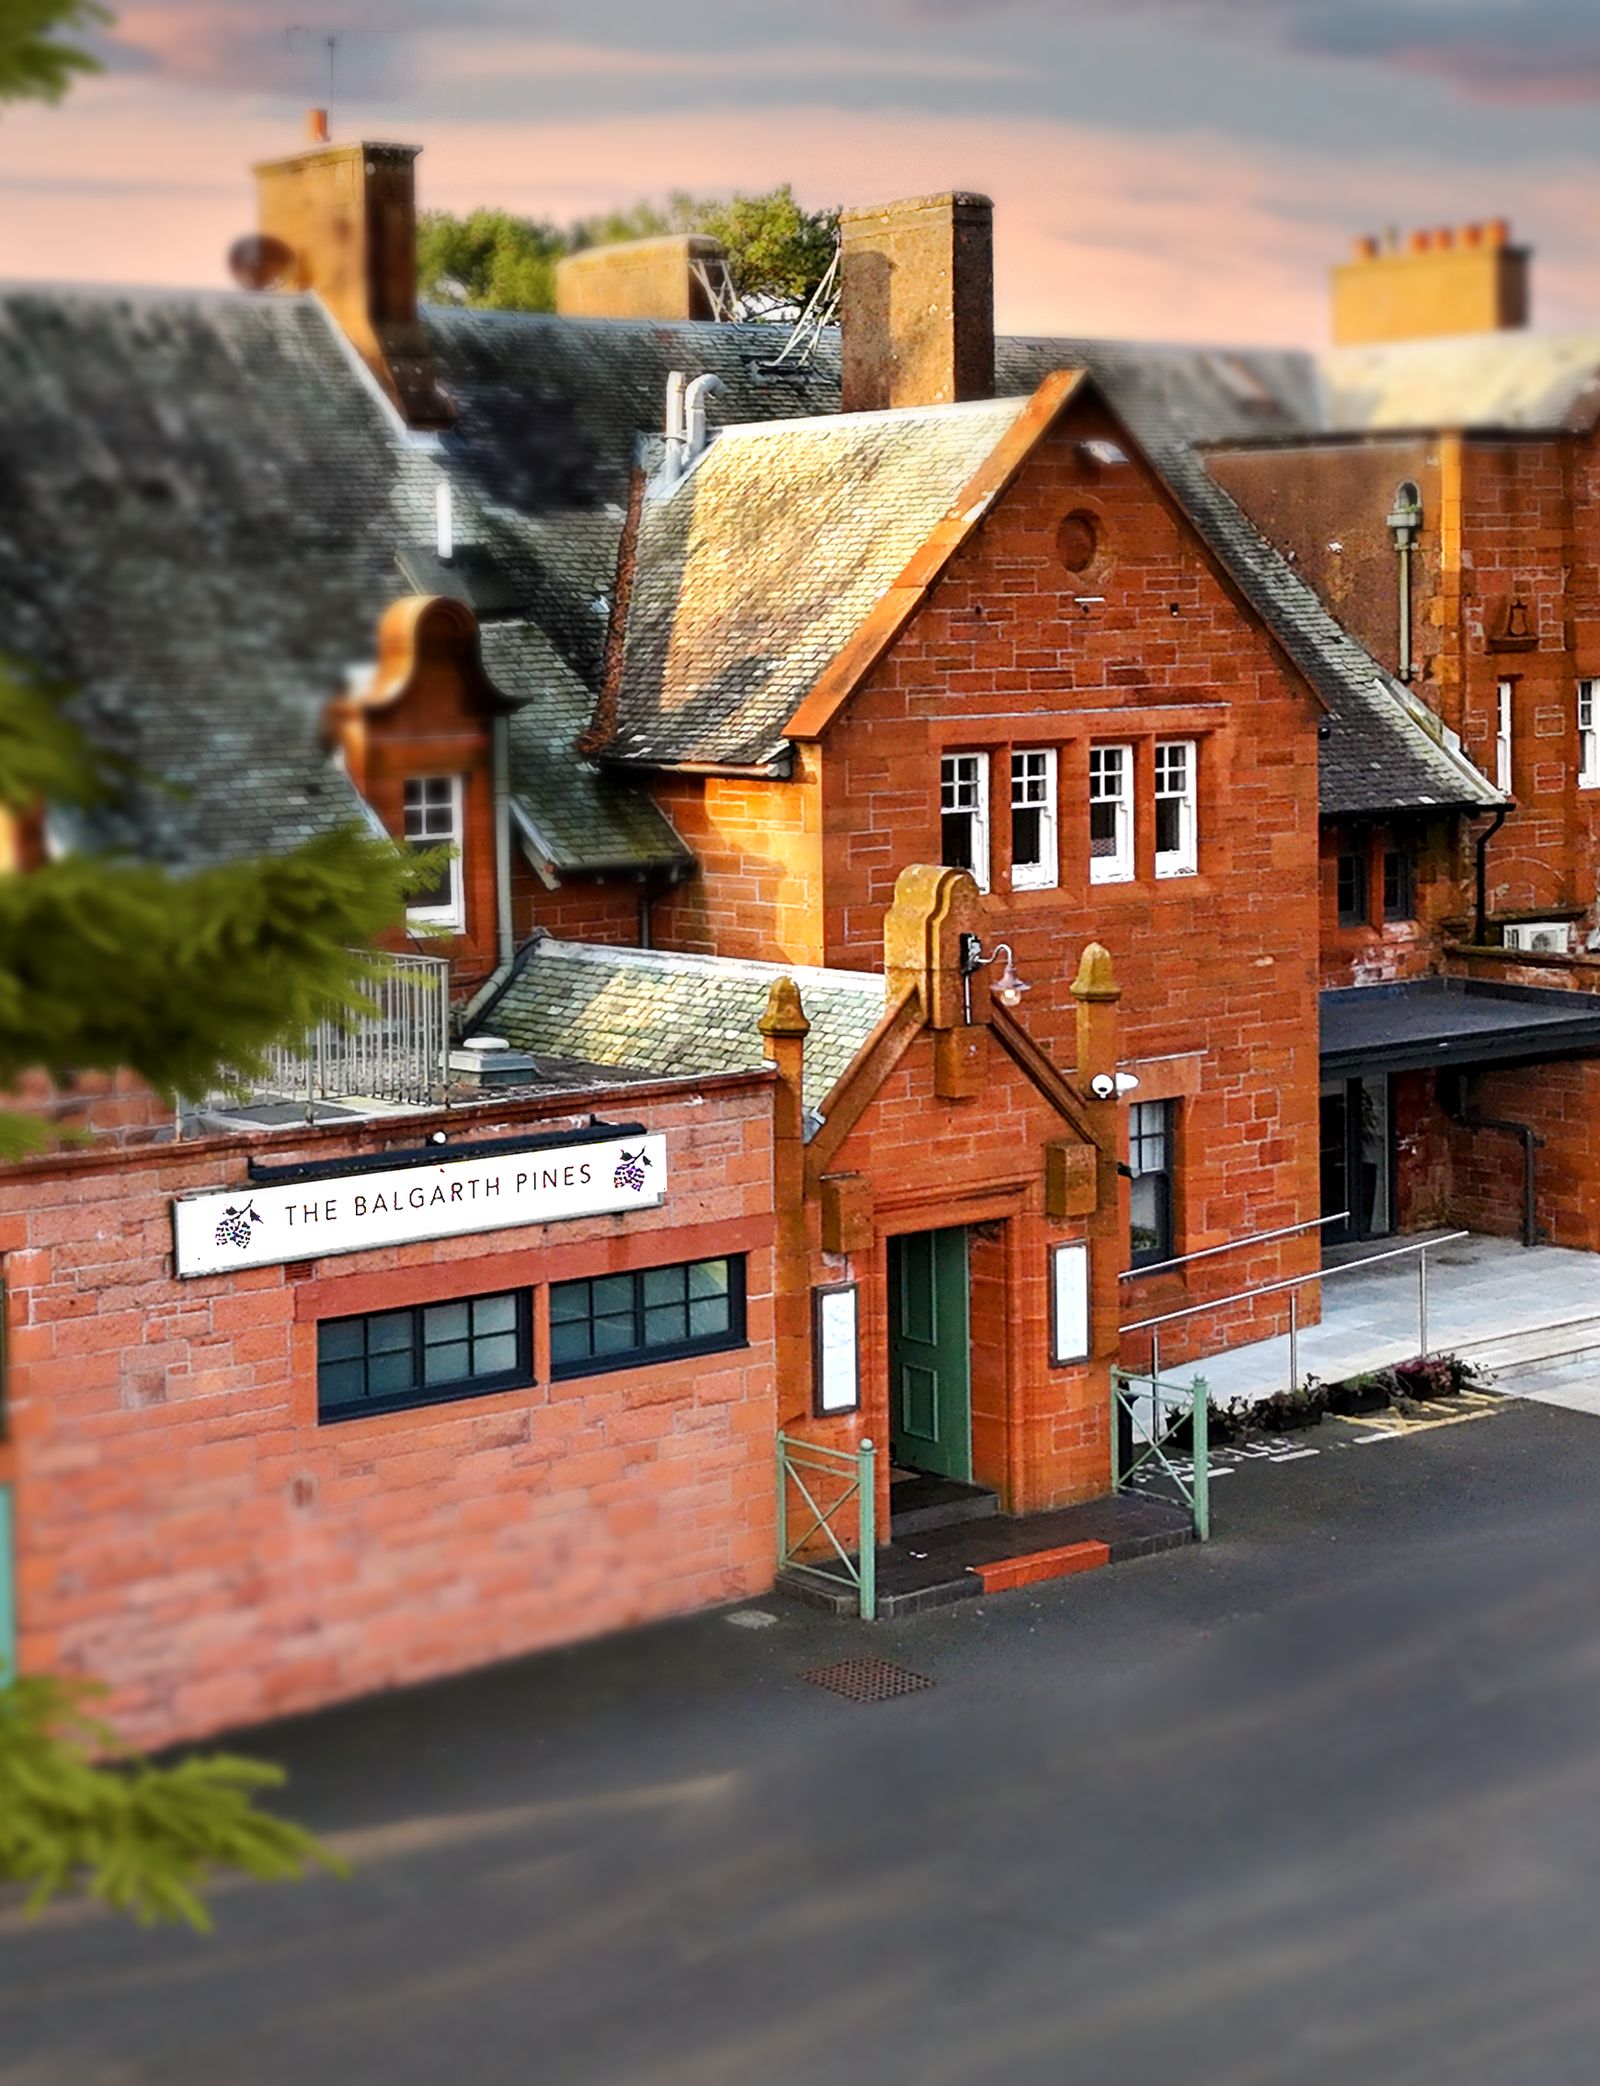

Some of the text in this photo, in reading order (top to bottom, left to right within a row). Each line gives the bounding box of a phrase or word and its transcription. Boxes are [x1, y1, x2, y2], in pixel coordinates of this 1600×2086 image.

[284, 1163, 592, 1226] THE BALGARTH PINES
